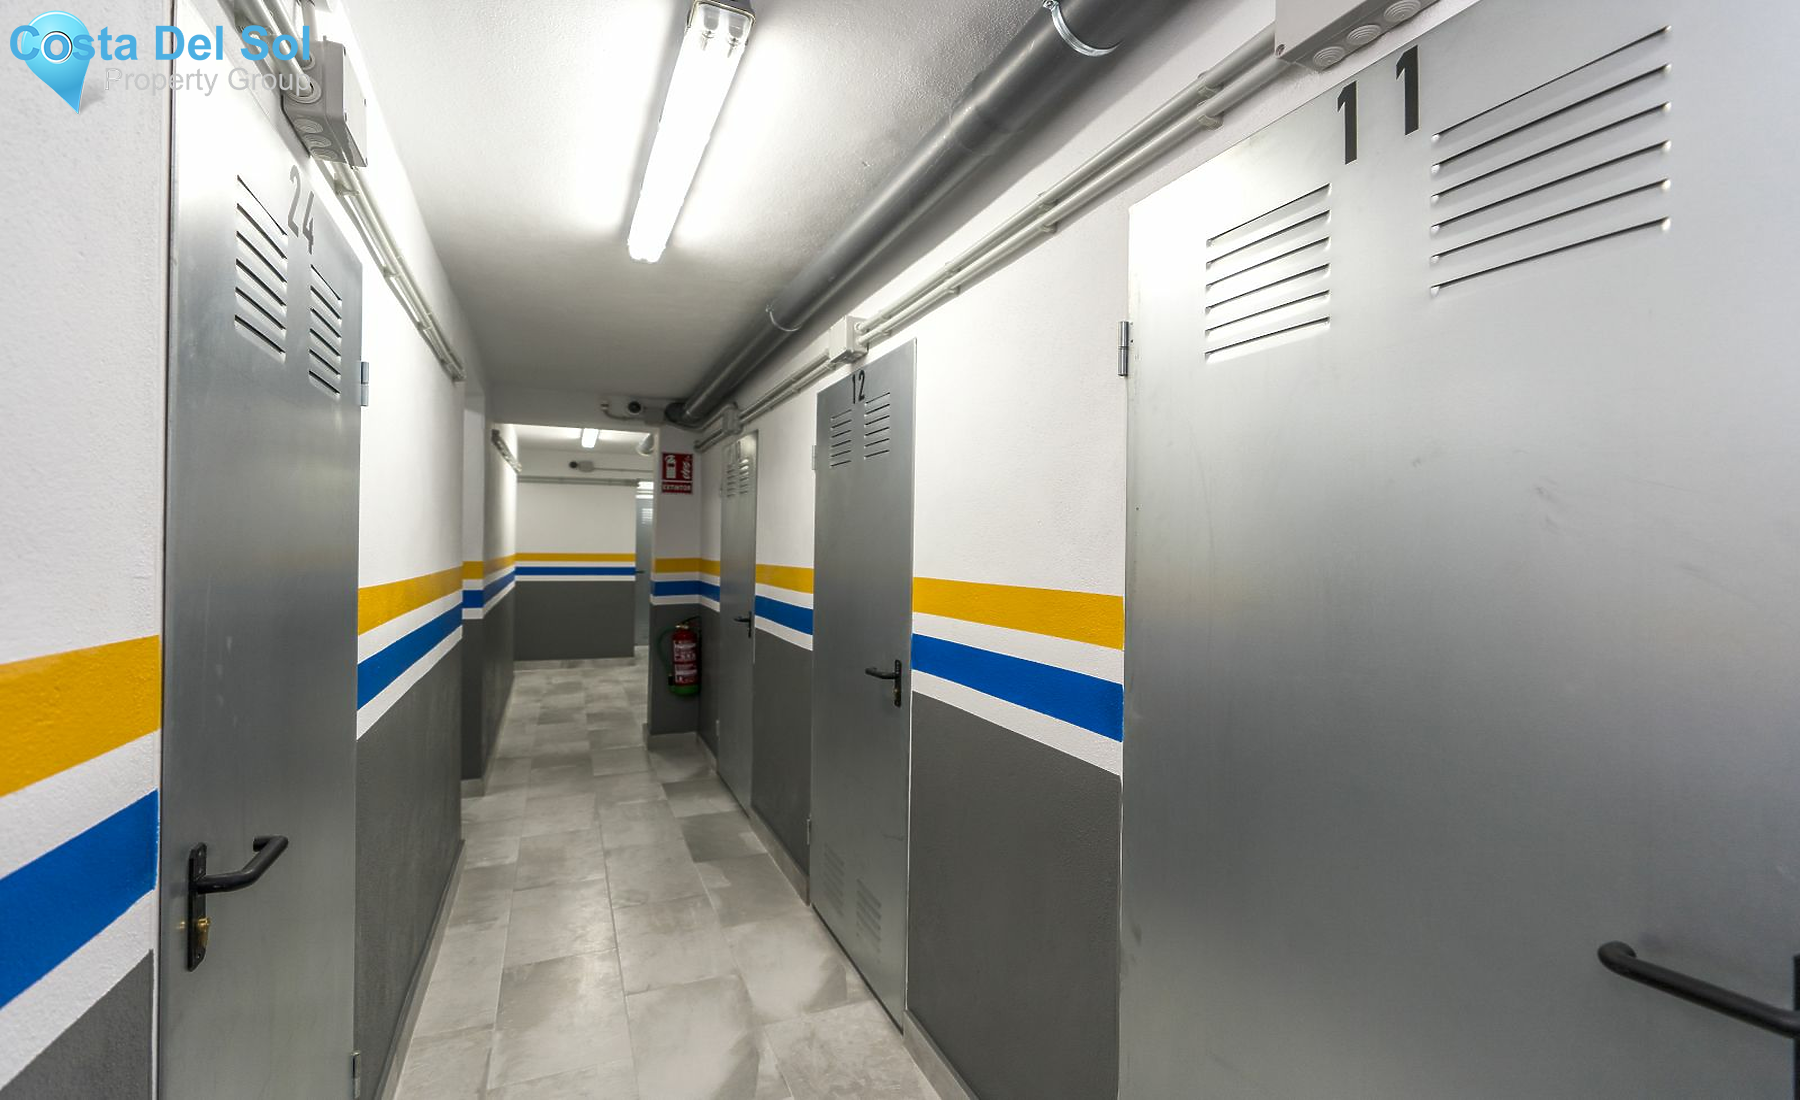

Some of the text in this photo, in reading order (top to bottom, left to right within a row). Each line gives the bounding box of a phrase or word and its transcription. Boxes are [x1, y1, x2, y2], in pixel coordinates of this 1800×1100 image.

[1337, 45, 1419, 165] 11
[288, 165, 314, 255] 24
[851, 370, 865, 404] 12
